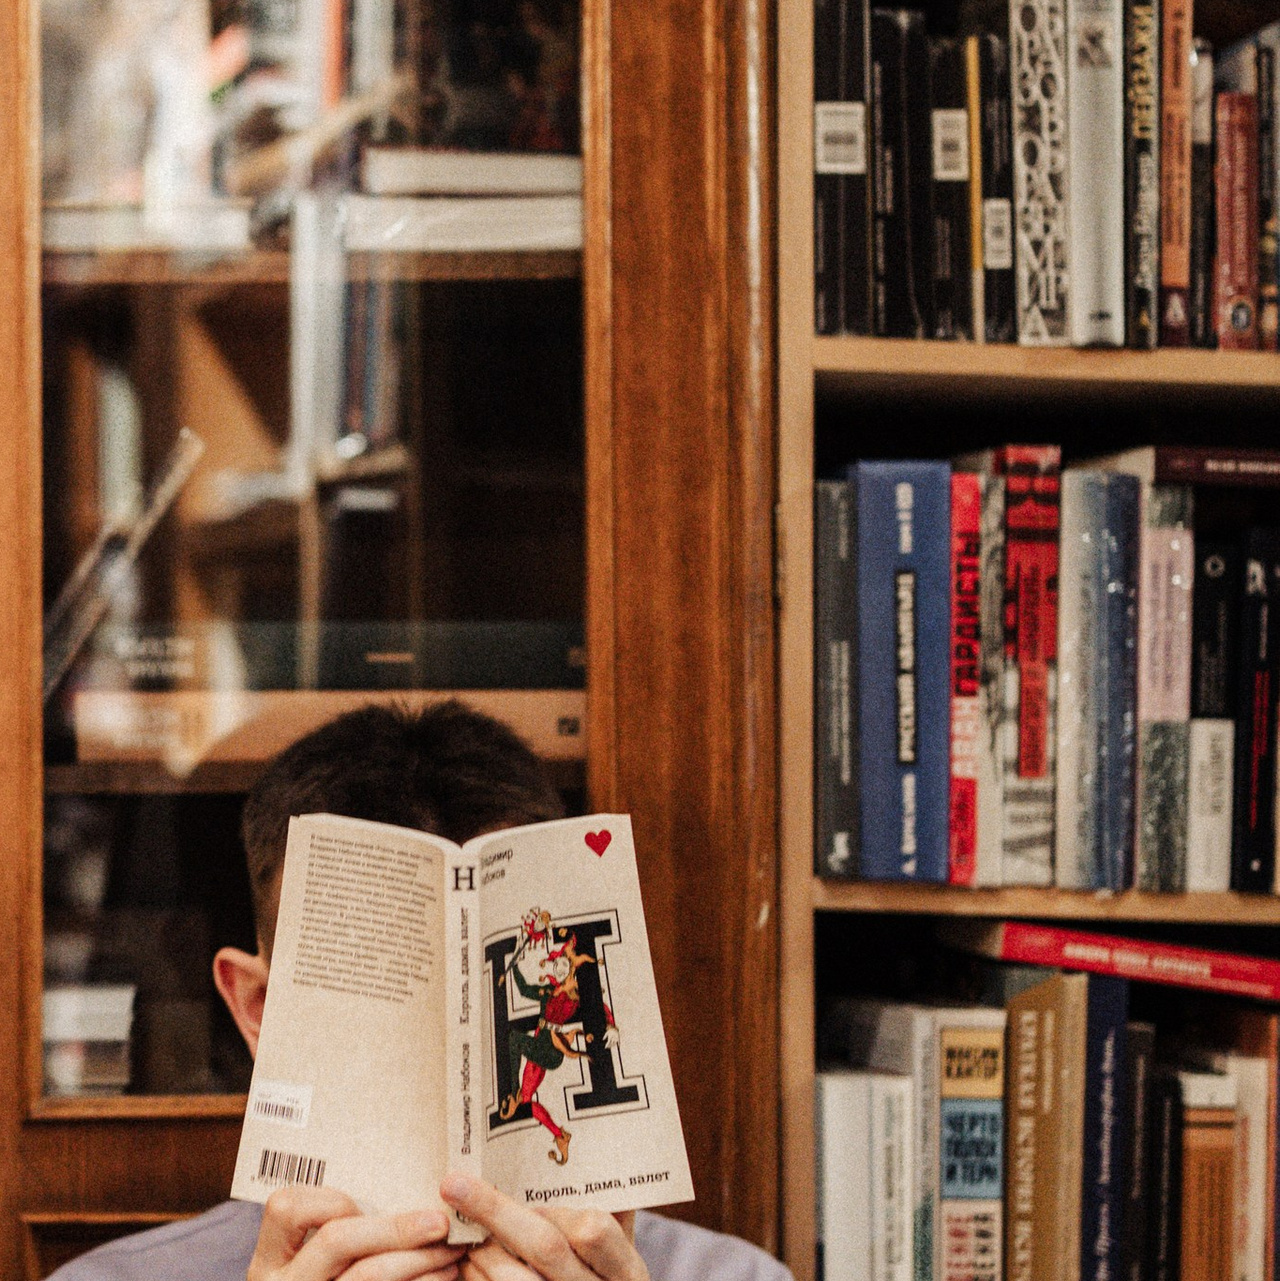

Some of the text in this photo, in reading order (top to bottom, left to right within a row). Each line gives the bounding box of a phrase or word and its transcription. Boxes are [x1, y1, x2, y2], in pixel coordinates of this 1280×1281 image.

[525, 1167, 671, 1202] Король, дама, валет
